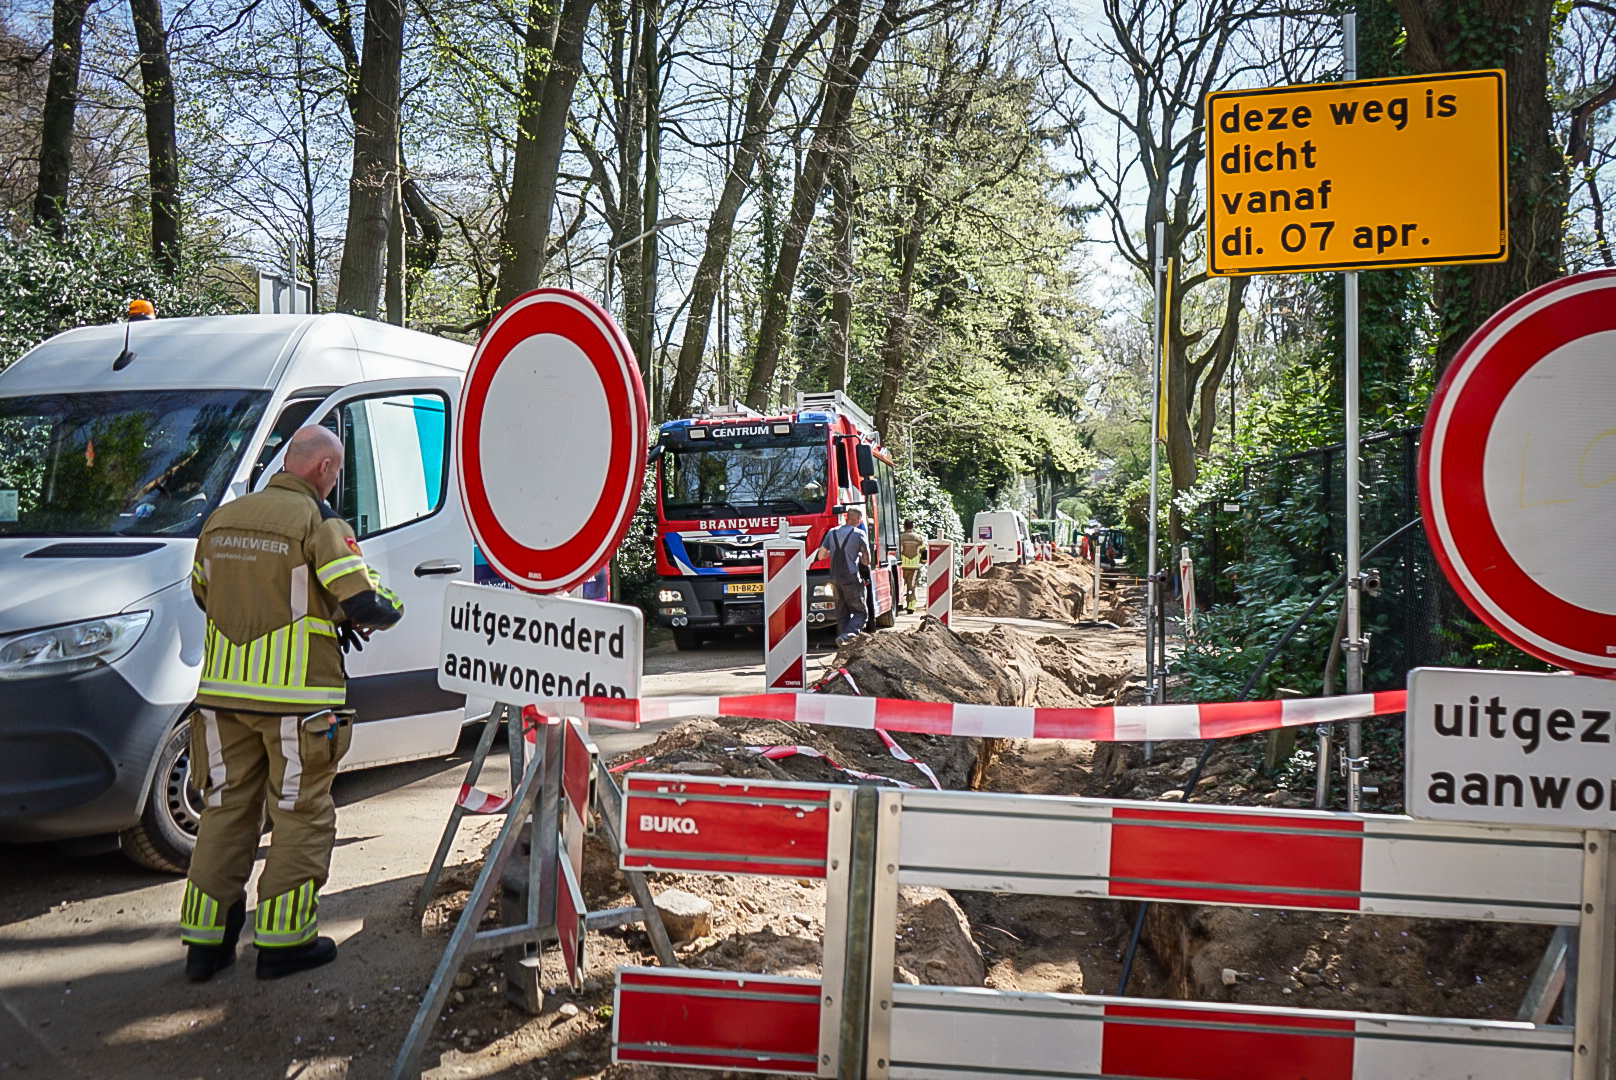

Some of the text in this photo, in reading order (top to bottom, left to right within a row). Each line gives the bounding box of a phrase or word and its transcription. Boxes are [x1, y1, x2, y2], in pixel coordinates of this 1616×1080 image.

[1220, 89, 1457, 133] deze weg is
[1220, 140, 1317, 174] dicht
[1221, 180, 1332, 215] vanaf
[1221, 221, 1430, 256] di. 07 apr.
[712, 426, 769, 438] CENTRUM
[450, 601, 624, 659] uitgezonderd
[444, 653, 626, 699] aanwonenden
[1434, 695, 1616, 754] uitgez
[640, 815, 699, 835] BUKO.
